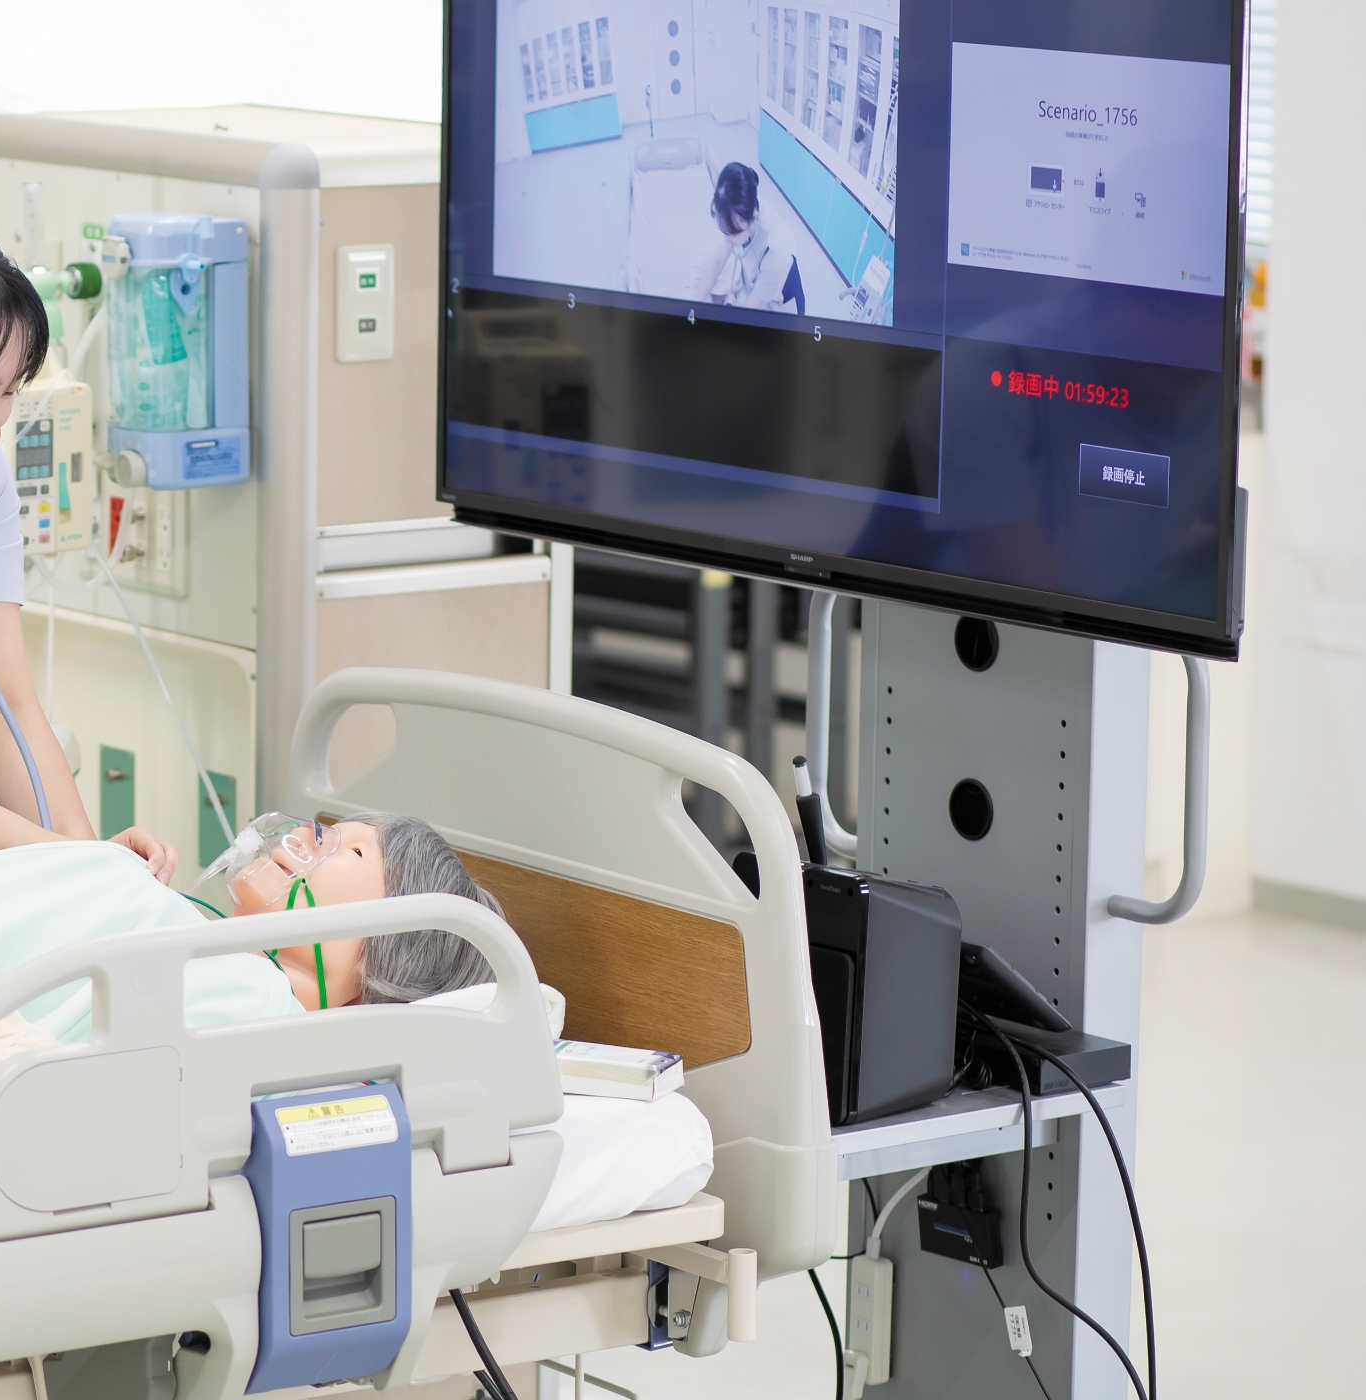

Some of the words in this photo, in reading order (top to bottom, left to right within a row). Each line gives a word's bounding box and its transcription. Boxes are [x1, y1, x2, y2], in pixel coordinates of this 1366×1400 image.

[1038, 100, 1138, 127] Scenario_1756
[567, 292, 576, 310] 3
[686, 308, 696, 325] 4
[813, 325, 822, 342] 5
[1008, 370, 1059, 399] 録画中
[1064, 381, 1130, 409] 01:59:23
[1102, 465, 1146, 486] 録画停止
[790, 553, 814, 562] SHARP
